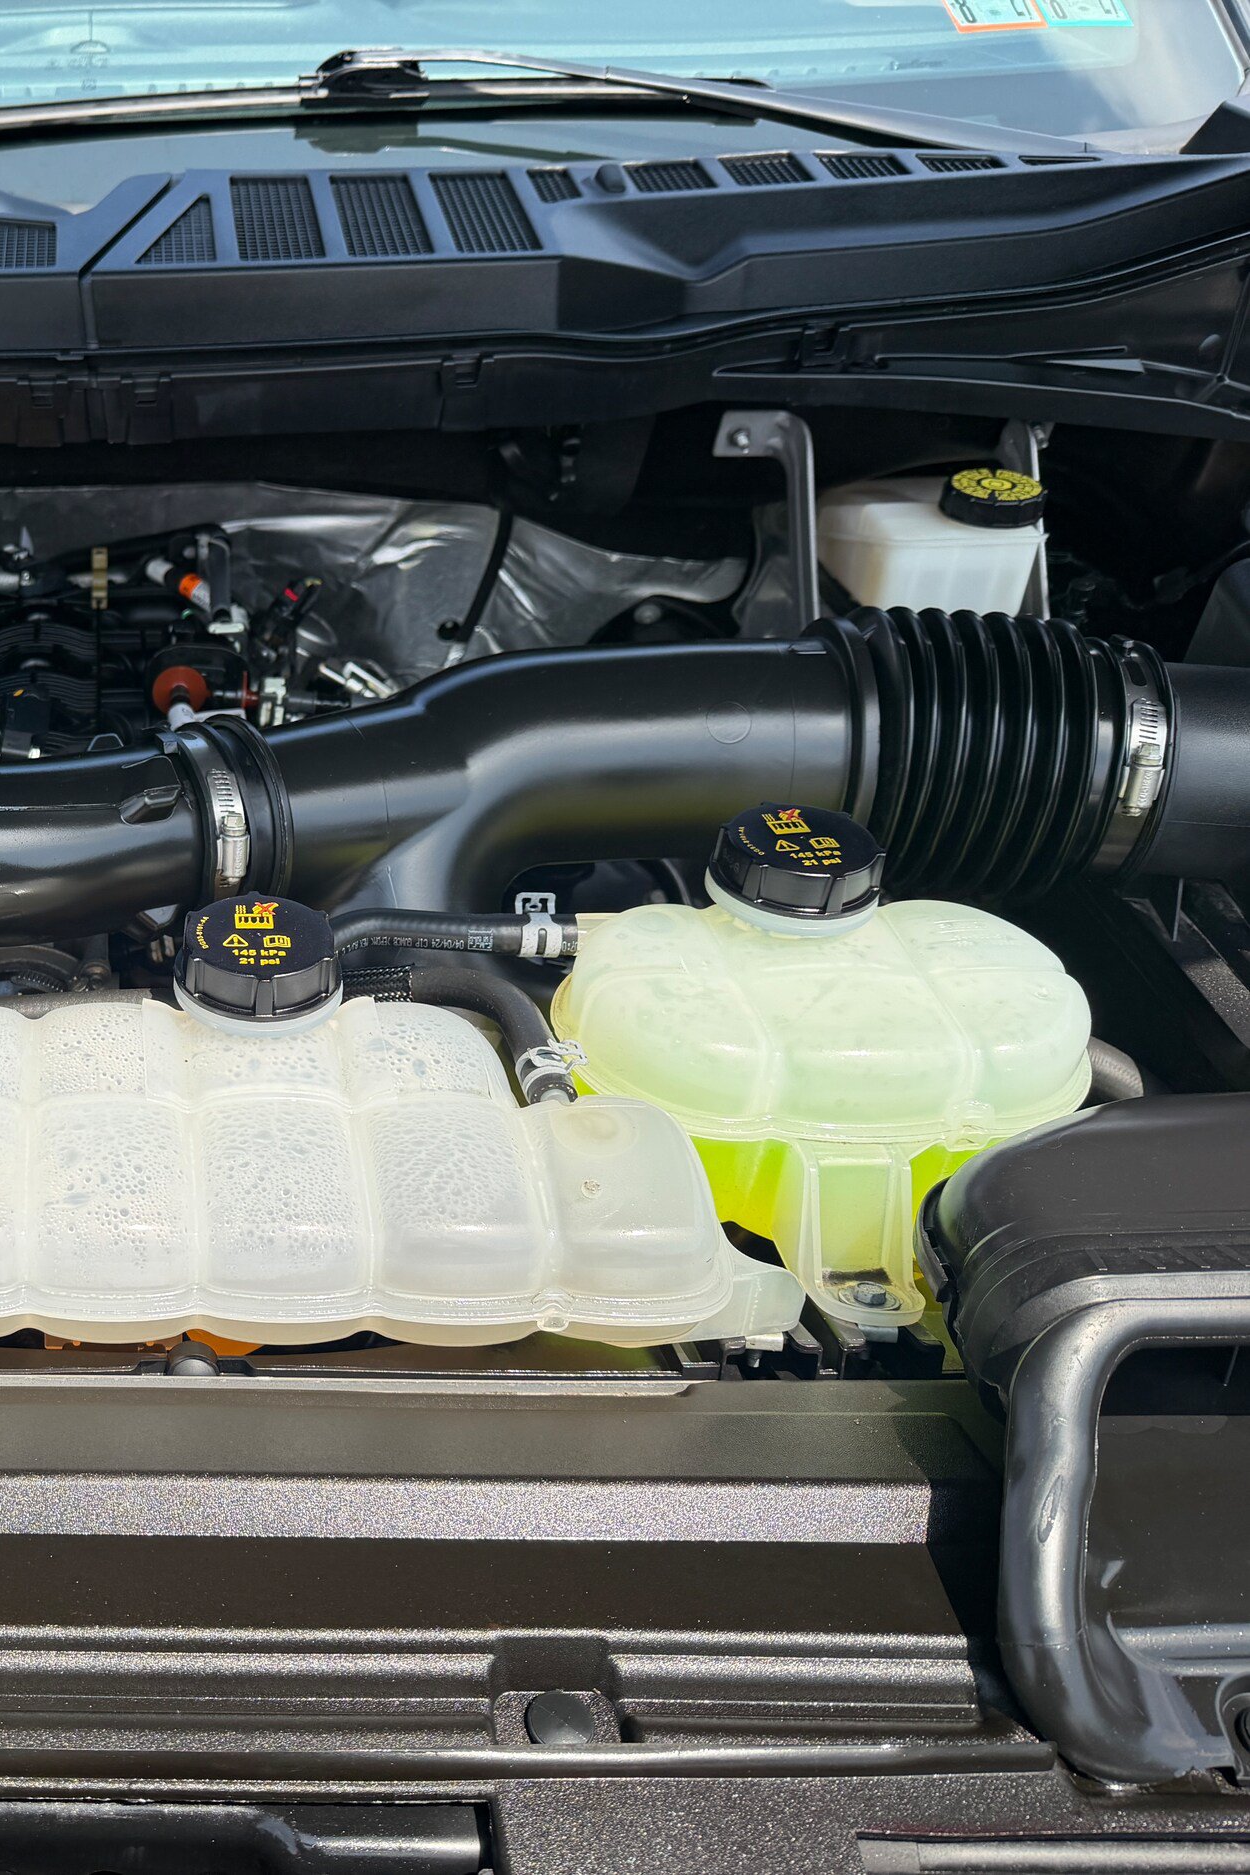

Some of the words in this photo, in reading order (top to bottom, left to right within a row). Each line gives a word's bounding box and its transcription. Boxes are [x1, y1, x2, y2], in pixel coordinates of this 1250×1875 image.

[790, 851, 813, 859] 145
[823, 858, 842, 866] psi
[260, 949, 286, 957] kPa
[260, 958, 280, 966] psi
